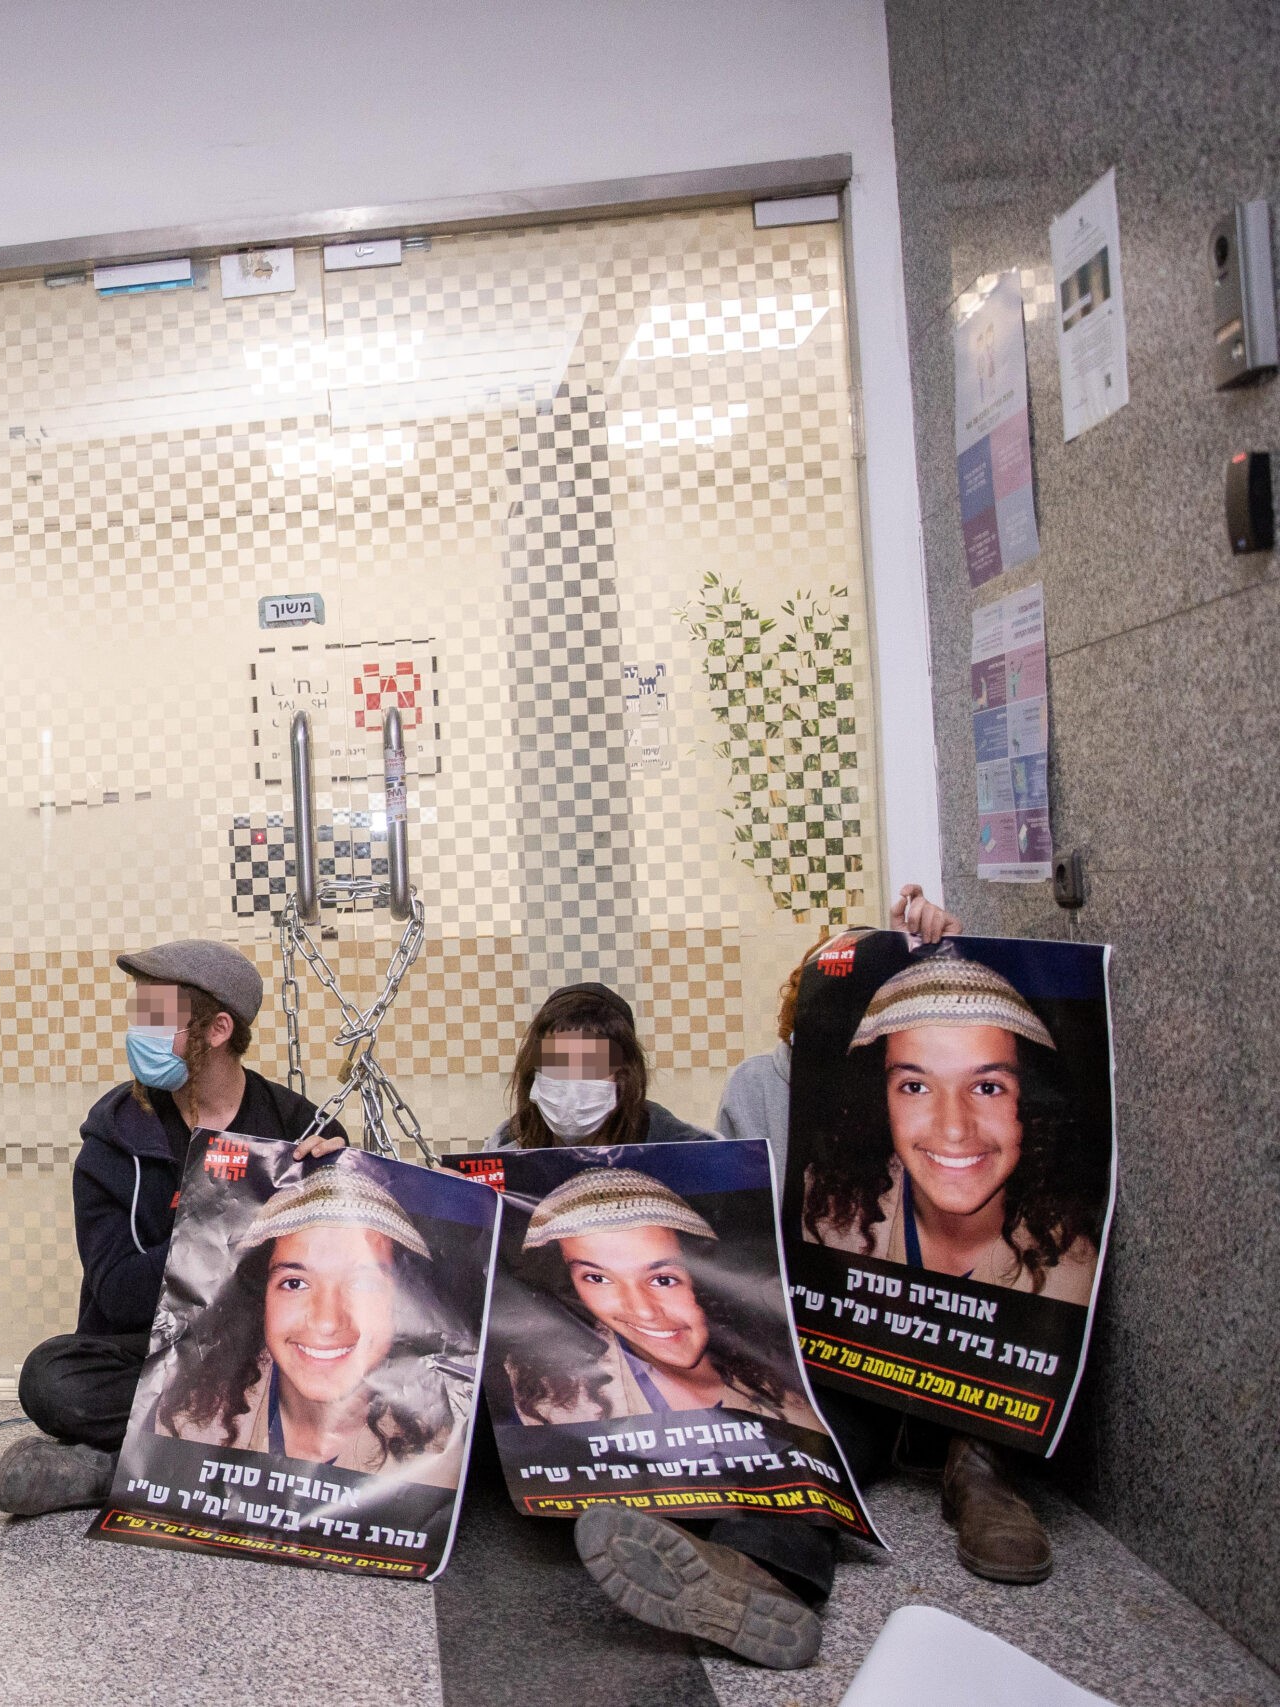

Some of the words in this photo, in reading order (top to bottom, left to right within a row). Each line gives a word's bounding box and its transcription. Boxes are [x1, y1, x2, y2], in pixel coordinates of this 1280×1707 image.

[270, 602, 312, 618] משוך
[817, 960, 853, 977] יהודי
[208, 1136, 249, 1152] יהודי
[205, 1154, 231, 1163] הורג
[232, 1156, 248, 1164] לא
[460, 1159, 503, 1173] יהודי
[203, 1164, 246, 1182] יהודי
[488, 1171, 504, 1181] לא
[846, 1268, 902, 1298] סנדק
[831, 1297, 877, 1325] ימ"ר
[909, 1283, 998, 1323] אהוביה
[884, 1312, 941, 1344] בלשי
[808, 1339, 838, 1361] ימ"ר
[947, 1328, 994, 1358] בידי
[839, 1346, 862, 1368] של
[997, 1342, 1059, 1375] נהרג
[862, 1356, 916, 1386] ההסתה
[916, 1370, 956, 1397] מפלג
[958, 1384, 984, 1406] את
[985, 1392, 1040, 1423] סוגרים
[588, 1431, 657, 1457] סנדק
[665, 1421, 766, 1447] אהוביה
[198, 1459, 261, 1486] סנדק
[577, 1463, 640, 1481] ימ"ר
[648, 1458, 721, 1478] בלשי
[725, 1451, 784, 1473] בידי
[790, 1449, 840, 1483] נהרג
[520, 1464, 570, 1483] ש"י
[127, 1479, 170, 1504] ש"י
[268, 1471, 361, 1508] אהוביה
[655, 1489, 721, 1507] ההסתה
[726, 1490, 772, 1506] מפלג
[776, 1489, 805, 1506] את
[178, 1488, 230, 1516] ימ"ר
[539, 1499, 574, 1511] ש"י
[619, 1496, 651, 1508] של
[806, 1489, 855, 1520] סוגרים
[116, 1514, 147, 1528] ש"י
[149, 1521, 184, 1535] ימ"ר
[237, 1502, 301, 1532] בלשי
[308, 1516, 360, 1540] בידי
[187, 1526, 213, 1539] של
[216, 1531, 275, 1551] ההסתה
[365, 1525, 428, 1549] נהרג
[277, 1544, 320, 1560] מפלג
[326, 1553, 353, 1565] את
[356, 1558, 413, 1573] סוגרים
